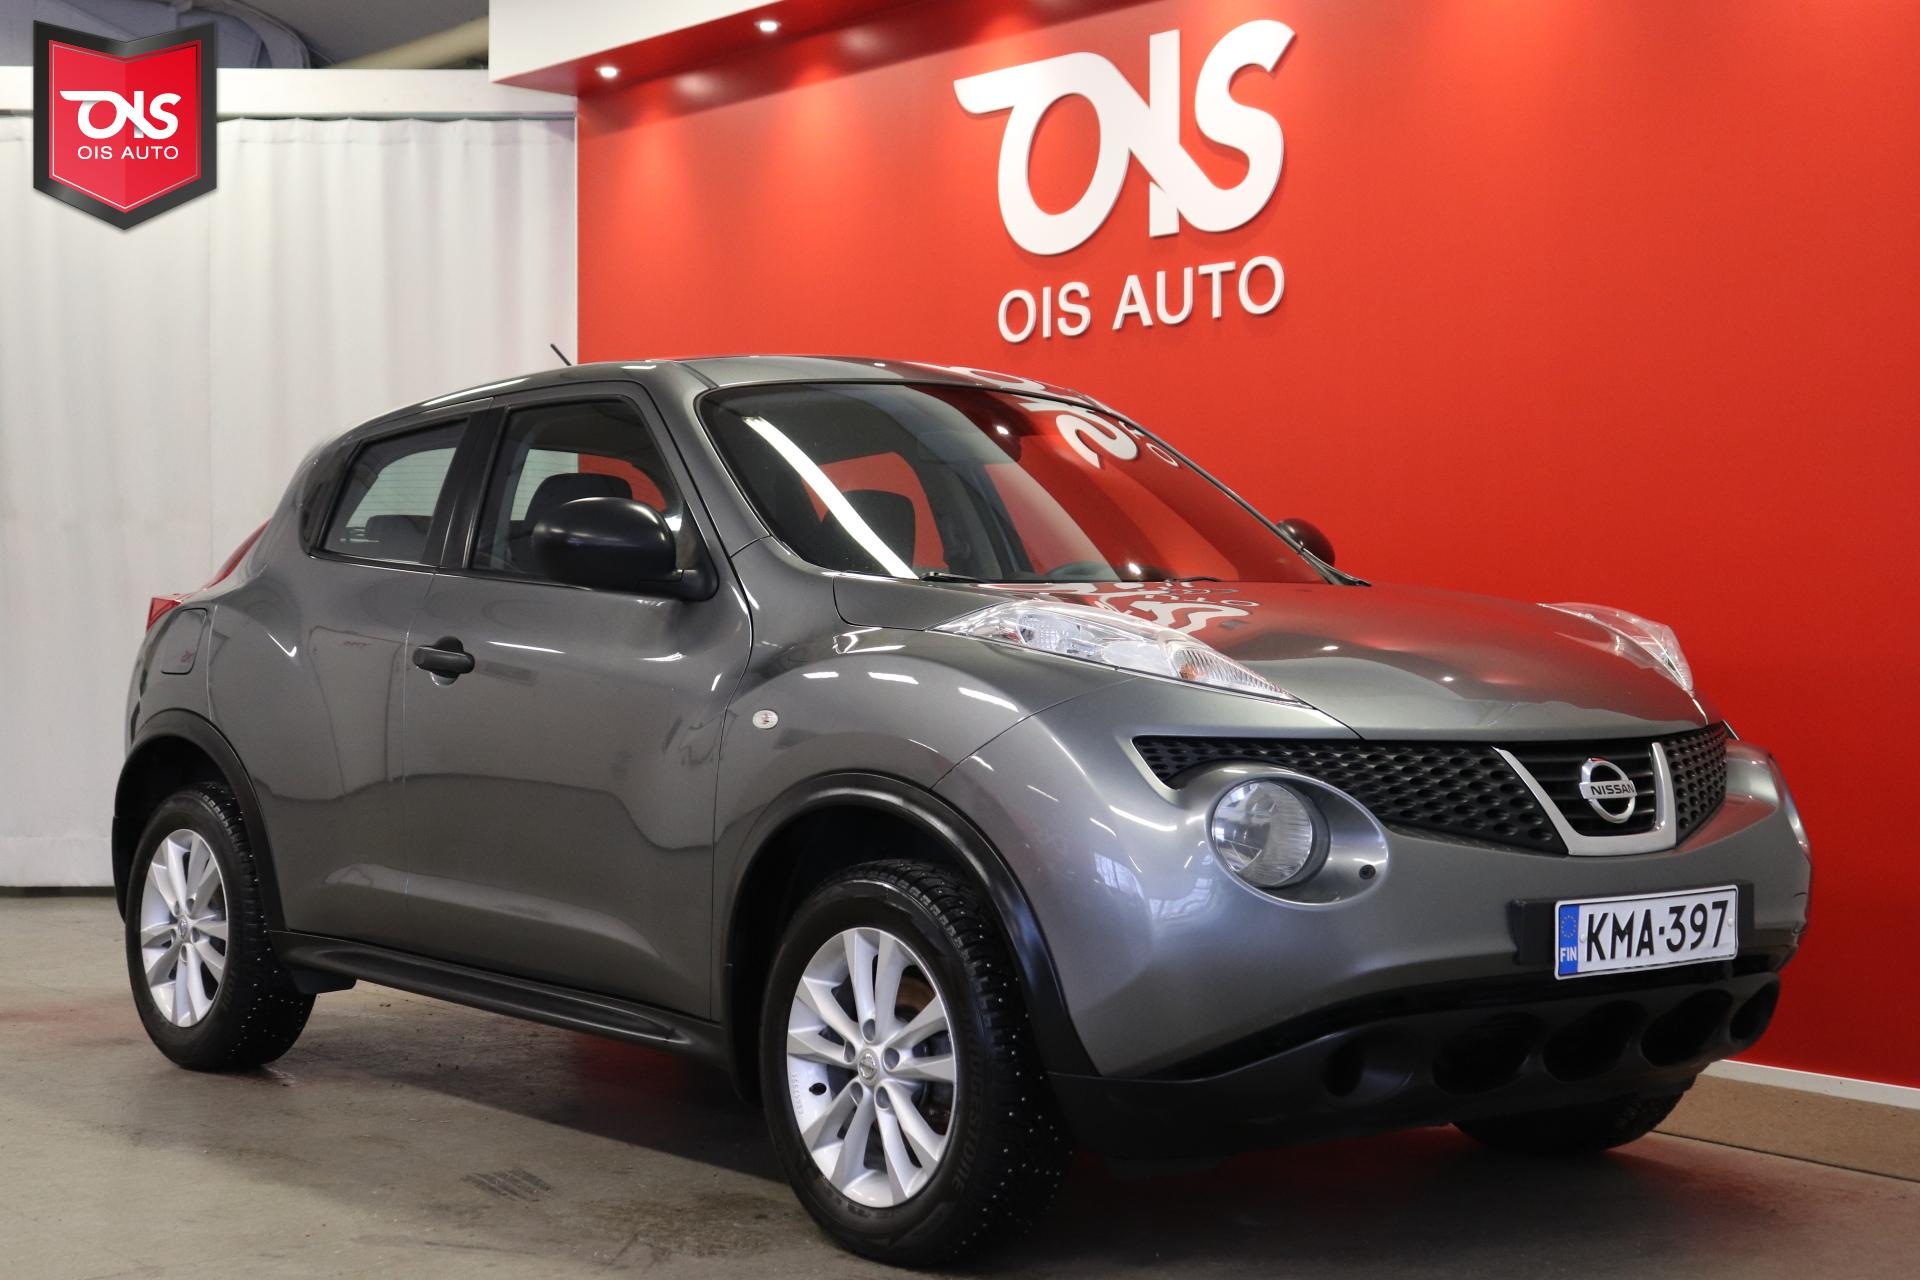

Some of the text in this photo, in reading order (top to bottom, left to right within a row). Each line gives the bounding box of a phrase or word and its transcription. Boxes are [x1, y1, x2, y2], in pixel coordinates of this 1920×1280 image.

[998, 255, 1285, 343] OIS AUTO
[1590, 780, 1636, 796] NISSAN
[1560, 900, 1729, 963] FIN KMA-397
